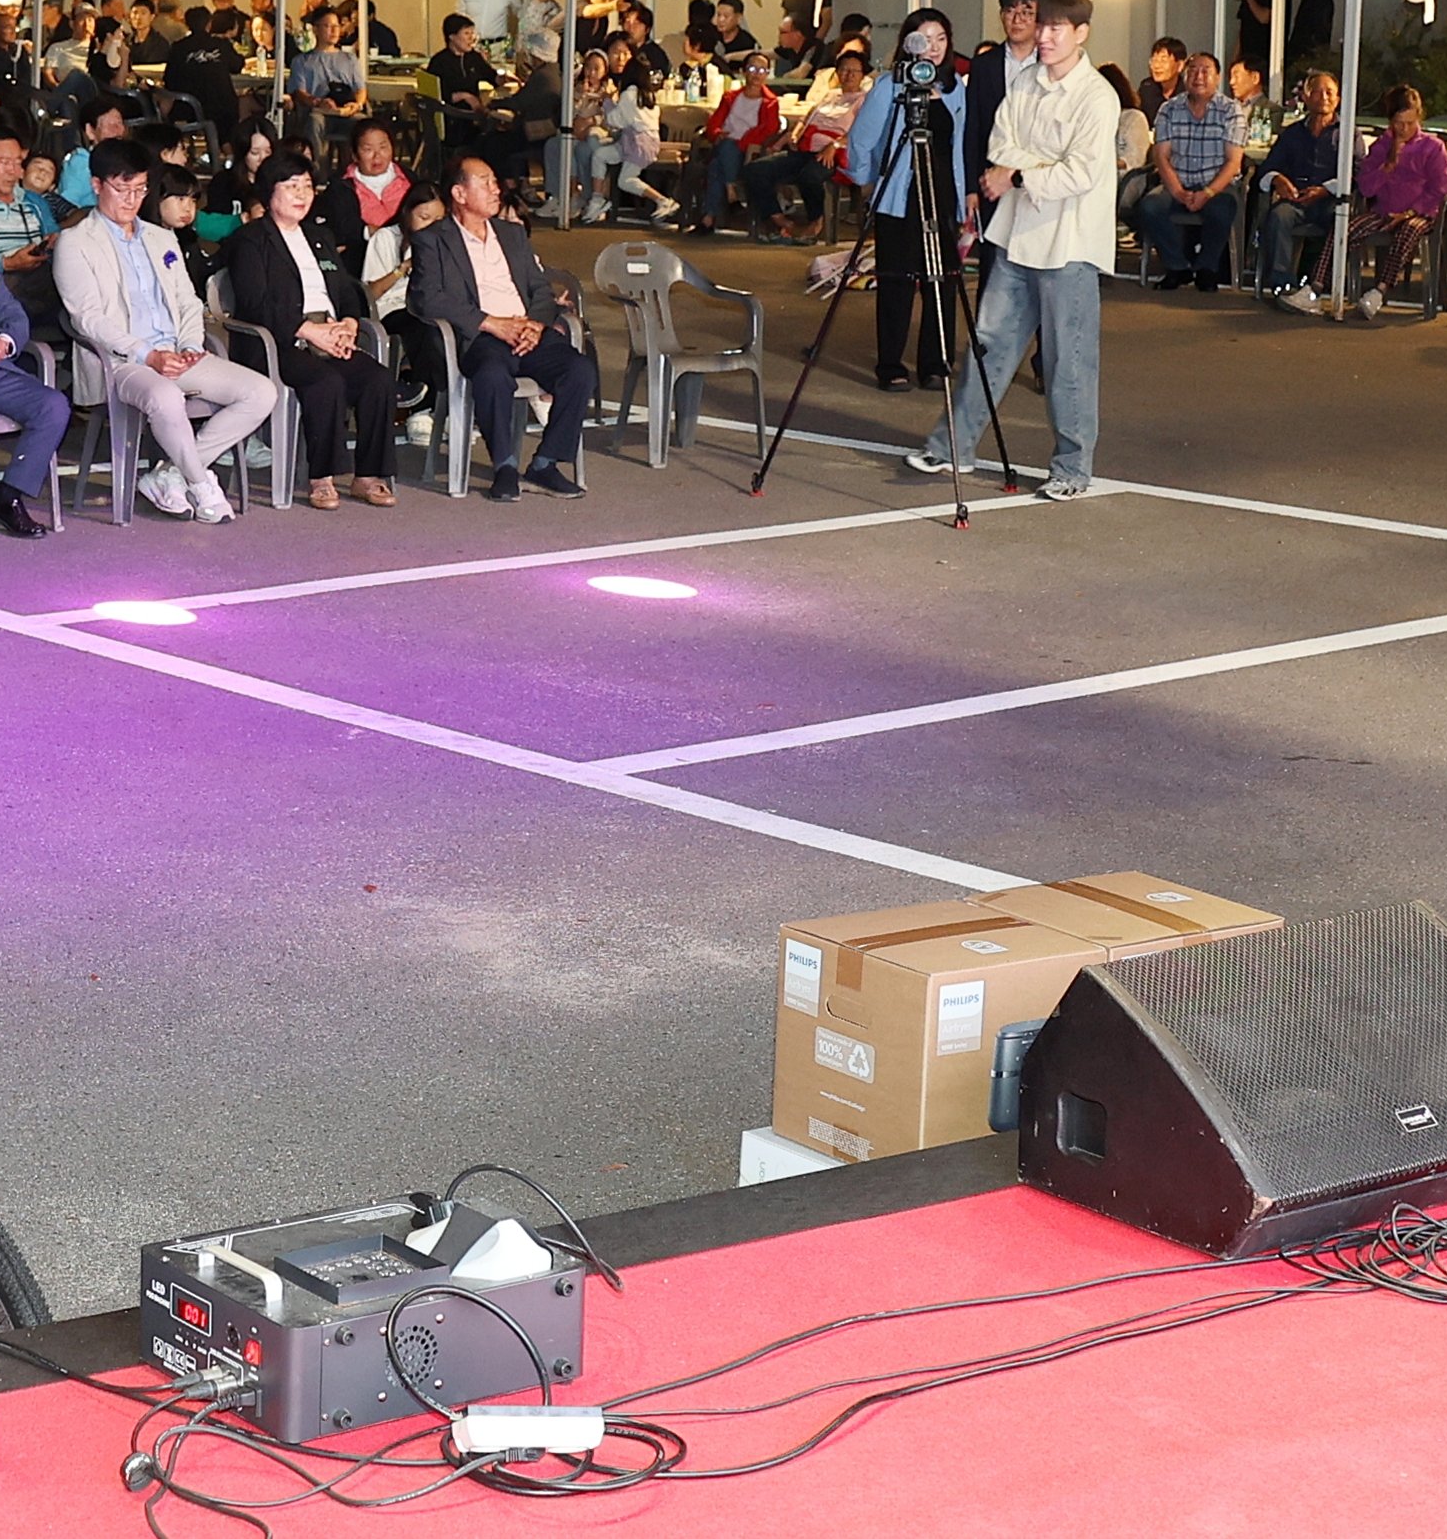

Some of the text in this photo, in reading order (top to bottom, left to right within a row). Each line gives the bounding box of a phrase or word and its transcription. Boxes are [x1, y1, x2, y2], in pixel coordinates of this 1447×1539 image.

[789, 951, 818, 970] PHILIPS
[943, 993, 980, 1008] PHILIPS
[818, 1039, 844, 1060] 100%
[152, 1279, 166, 1296] LED
[184, 1304, 206, 1328] 001
